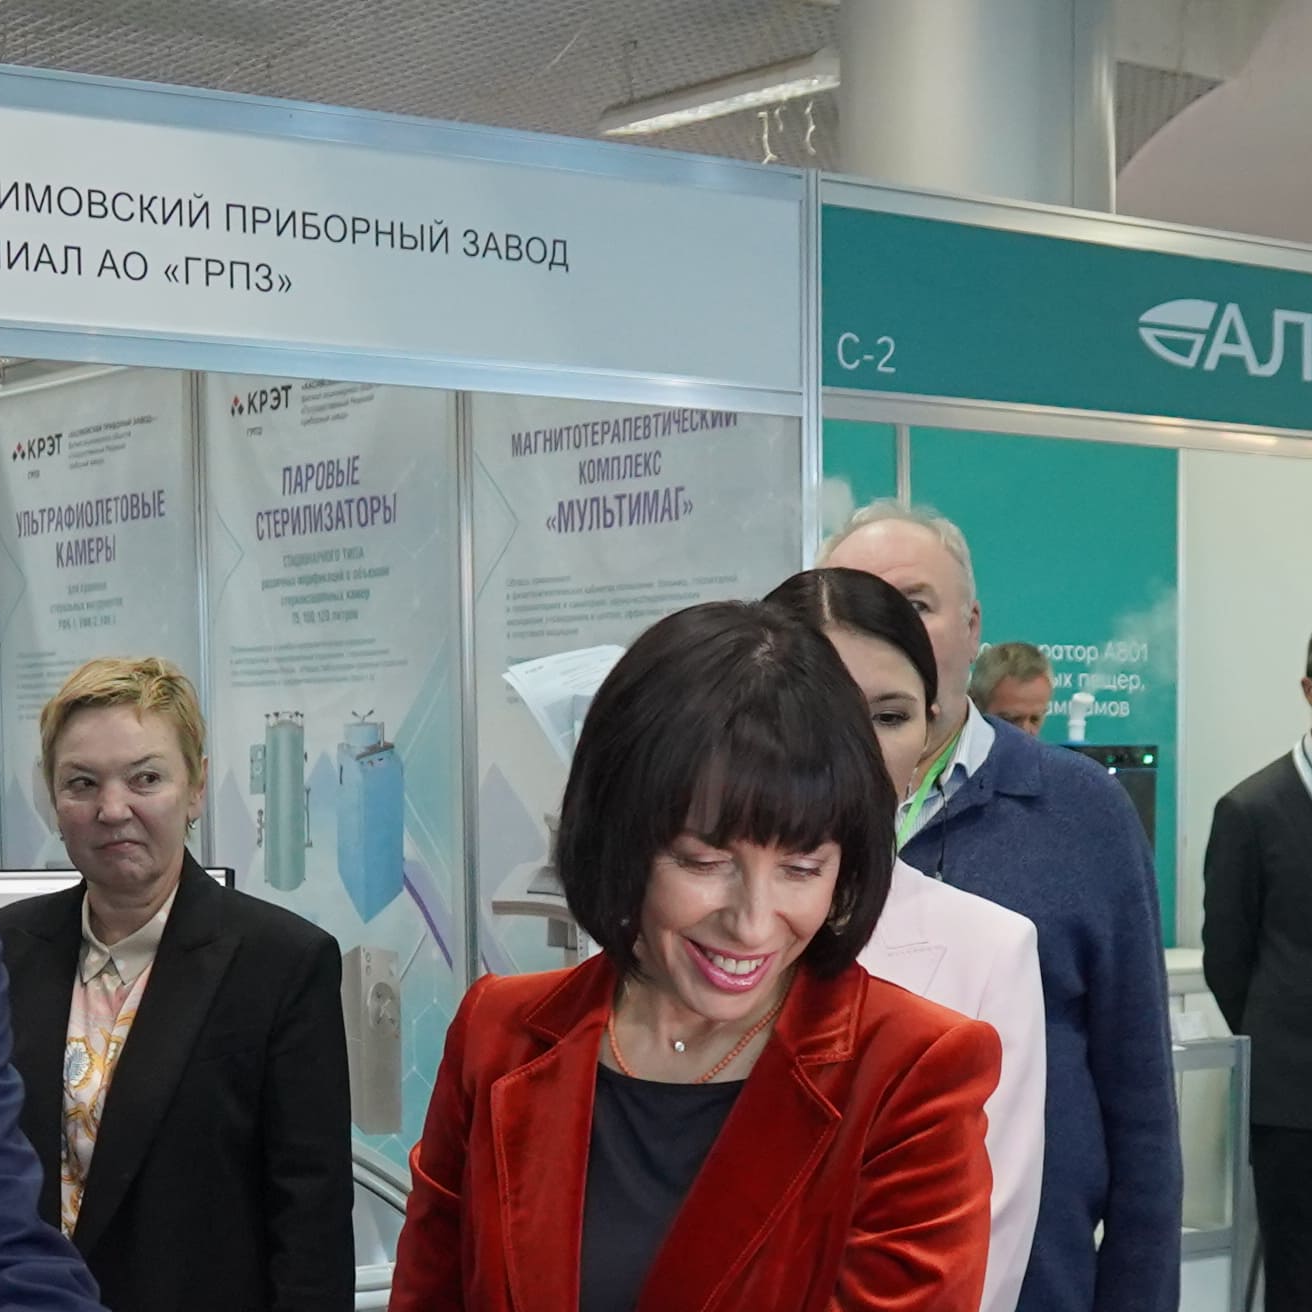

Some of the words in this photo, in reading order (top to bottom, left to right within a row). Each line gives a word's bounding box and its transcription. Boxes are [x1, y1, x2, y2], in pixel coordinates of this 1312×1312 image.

[224, 202, 450, 256] ПРИБОРНЫЙ
[461, 229, 571, 273] ЗАВОД
[96, 247, 149, 282] АО
[163, 256, 294, 295] «ГРПЗ»
[247, 384, 293, 416] КРЭТ
[26, 433, 63, 461] КРЭТ
[578, 450, 663, 486] КОМПЛЕКС
[281, 454, 361, 497] ПАРОВЫЕ
[15, 489, 167, 539] УЛЬТРАФИОЛЕТОВЫЕ
[255, 492, 398, 541] СТЕРИЛИЗАТОРЫ
[546, 485, 694, 535] «МУЛЬТИМАГ»
[55, 533, 117, 569] КАМЕРЫ
